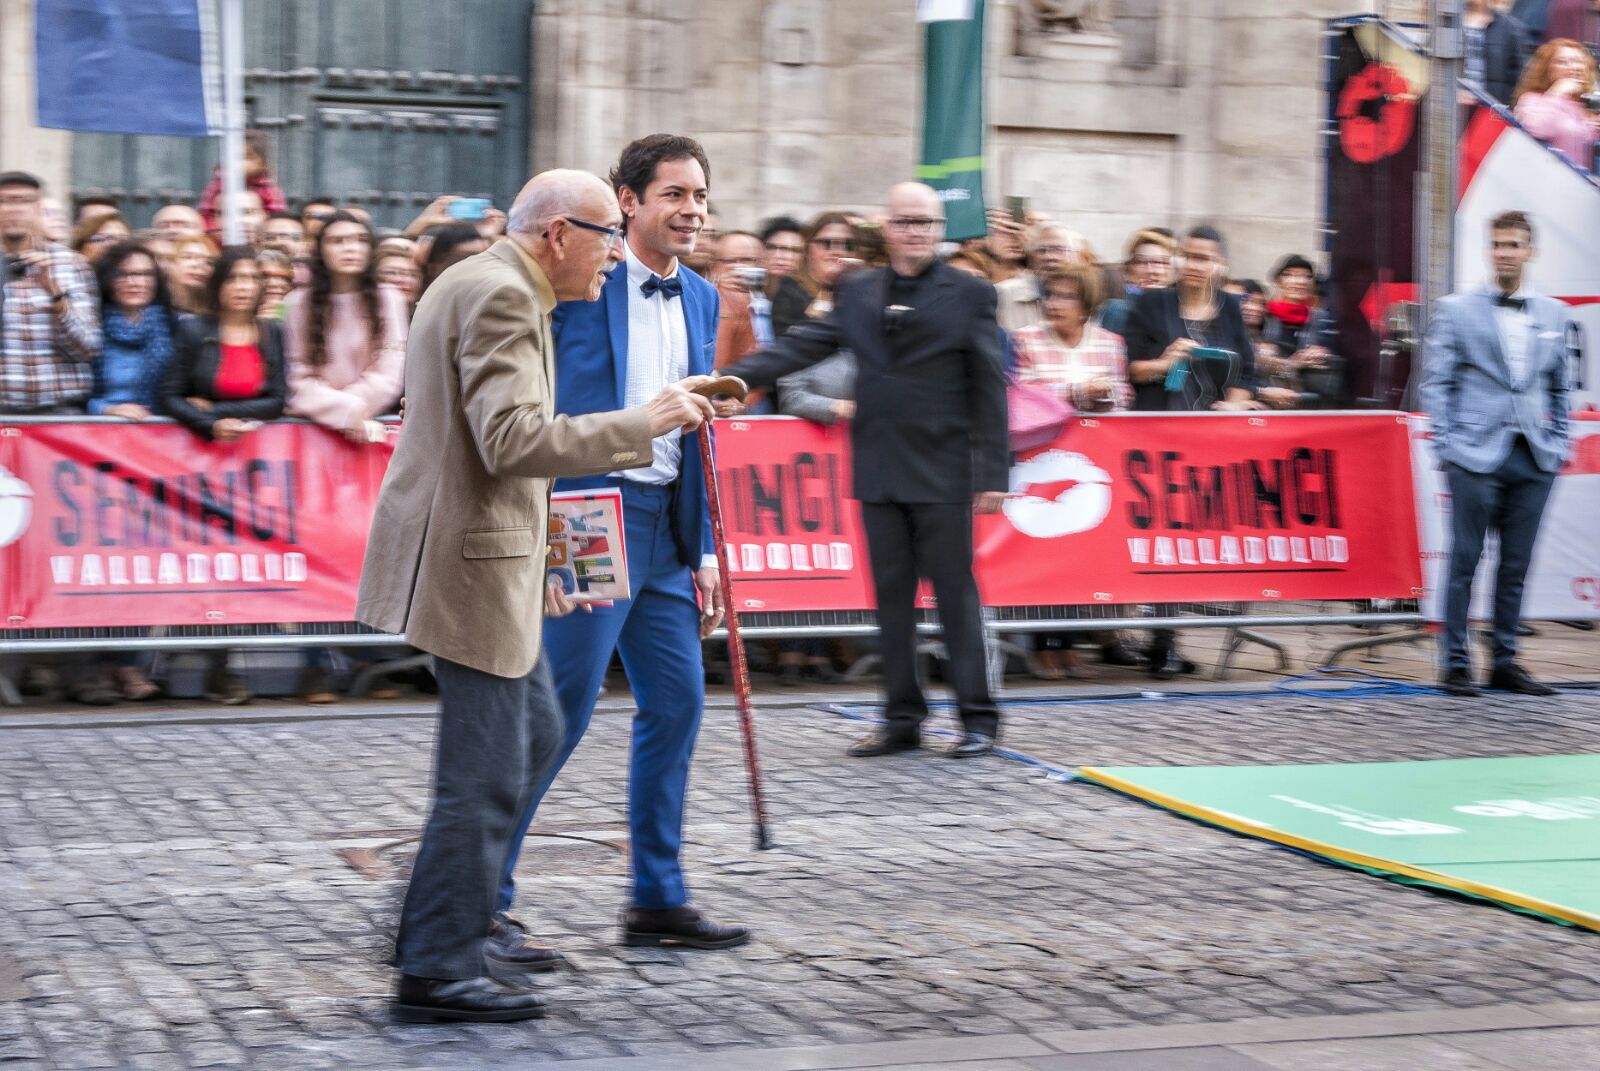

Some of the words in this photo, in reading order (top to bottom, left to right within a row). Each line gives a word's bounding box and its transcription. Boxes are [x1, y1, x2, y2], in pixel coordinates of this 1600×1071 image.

[726, 542, 853, 573] ADOLID
[1127, 536, 1350, 566] VALLADOLID
[50, 552, 308, 586] VALLADOLID
